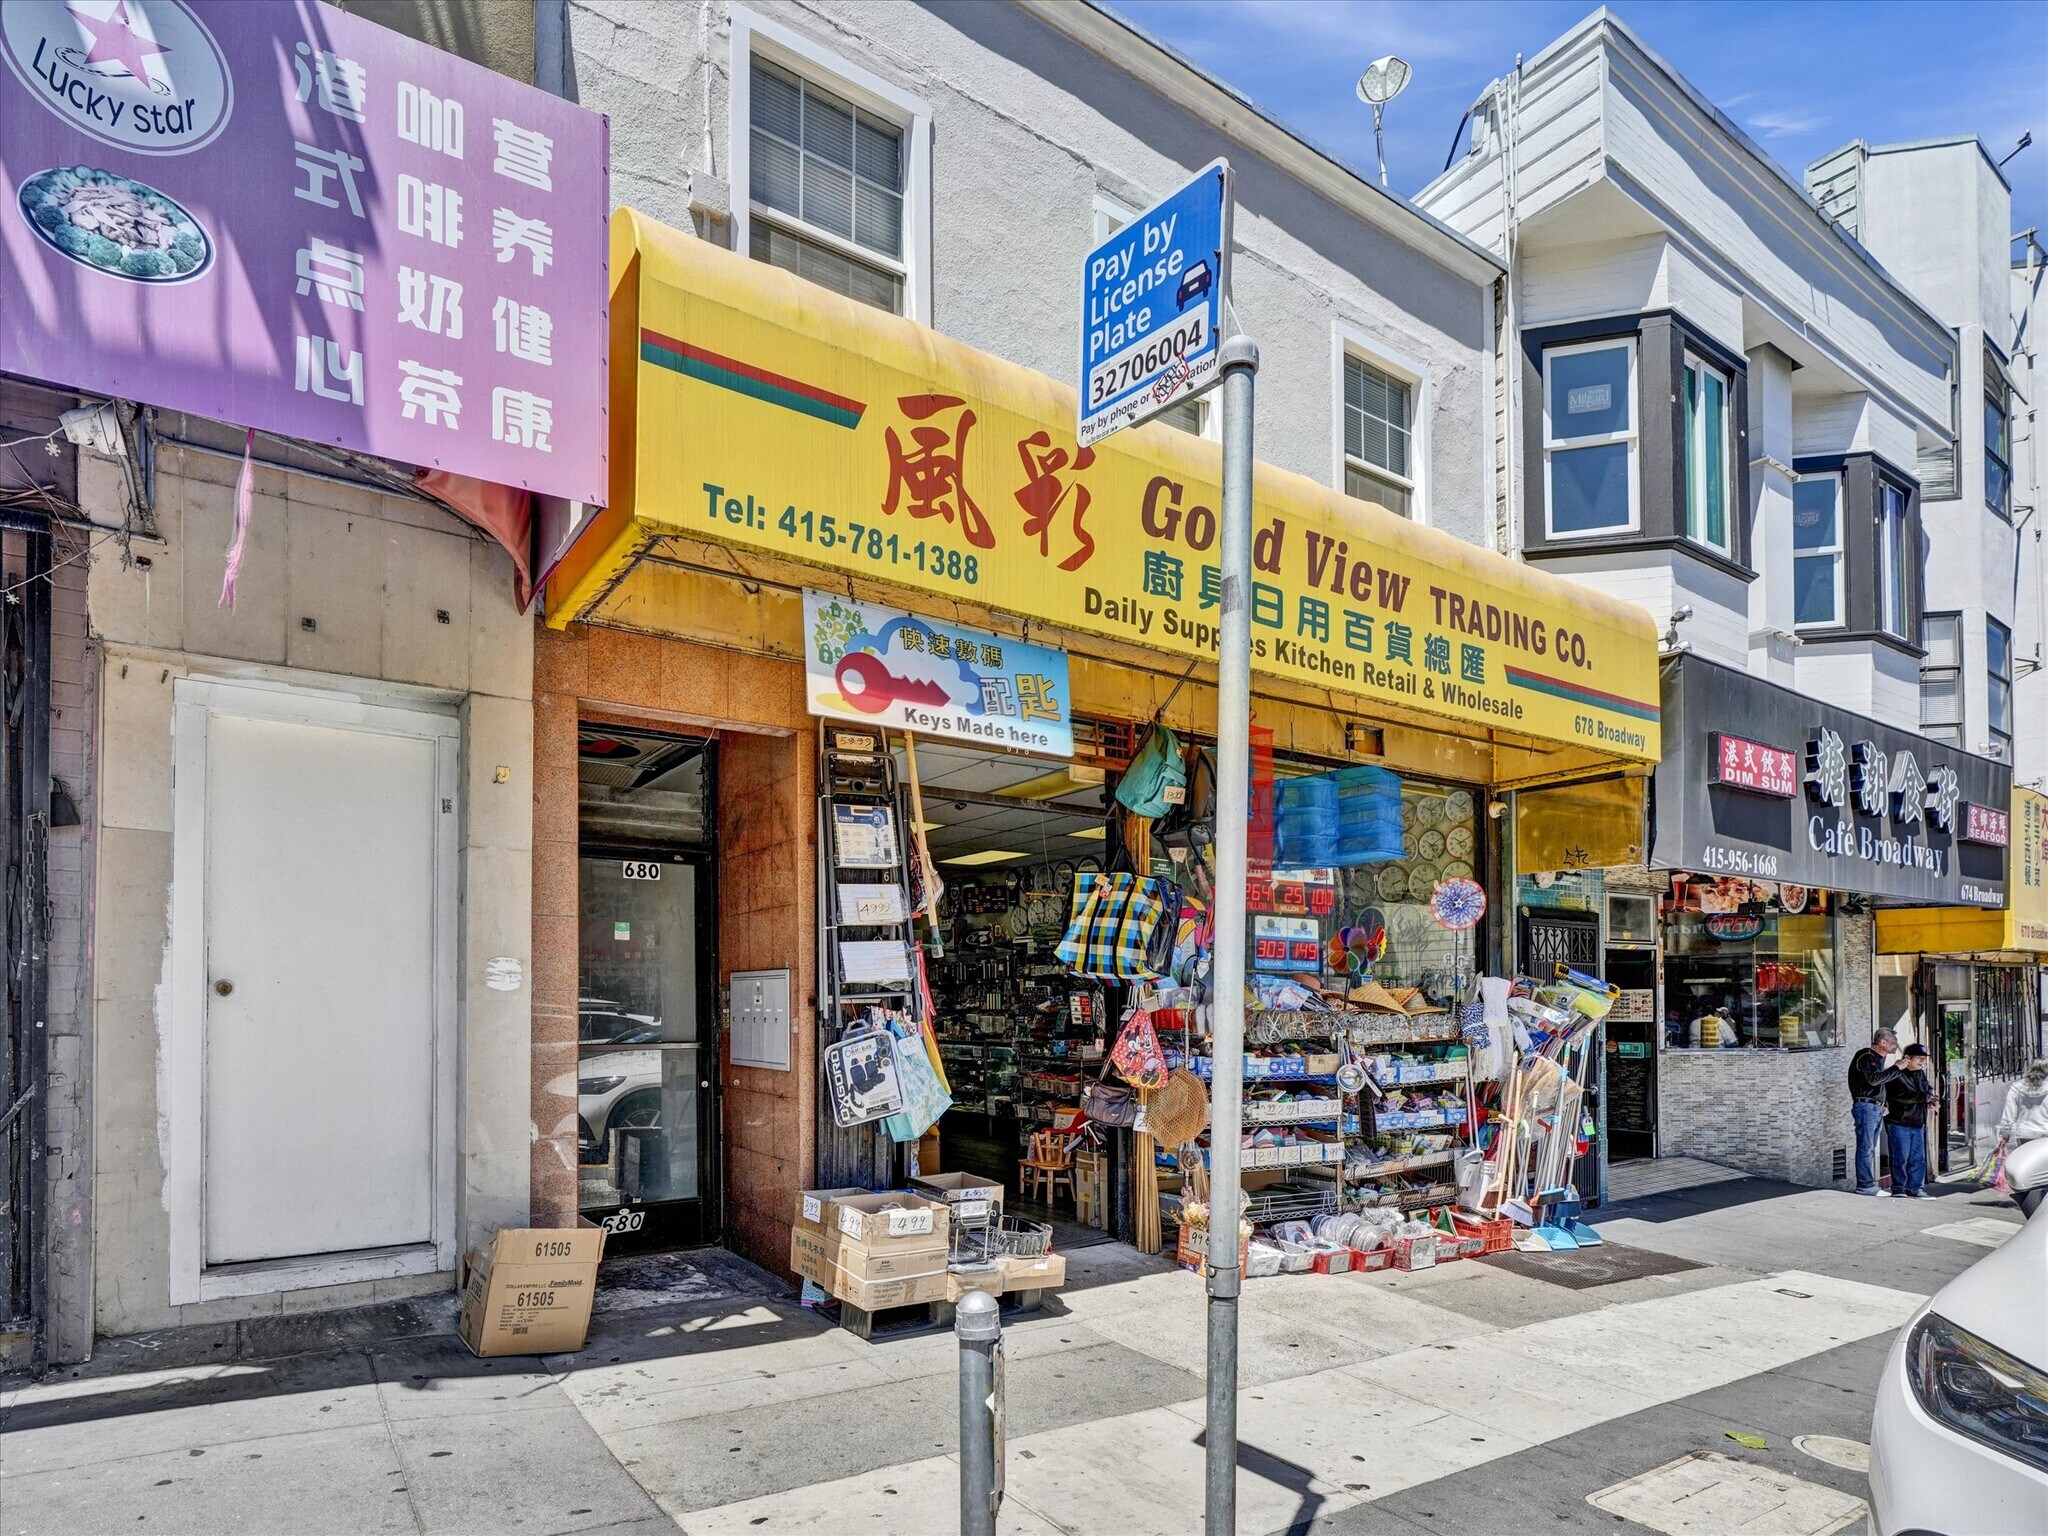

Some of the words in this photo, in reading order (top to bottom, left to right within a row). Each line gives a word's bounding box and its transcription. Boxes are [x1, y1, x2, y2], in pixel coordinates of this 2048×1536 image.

[31, 37, 122, 127] Lucky
[133, 96, 195, 136] star
[294, 41, 367, 407] 港式点心
[397, 81, 464, 430] 咖啡奶茶
[1092, 241, 1135, 291] Pay
[1143, 212, 1177, 257] by
[491, 117, 553, 454] 营养健康
[1091, 248, 1184, 327] License
[1090, 307, 1151, 362] Plate
[1092, 318, 1202, 404] 32706004
[1081, 423, 1096, 436] Pay
[1097, 416, 1108, 429] by
[1110, 400, 1138, 423] phone
[1140, 392, 1150, 405] or
[1184, 357, 1216, 381] tation
[1570, 390, 1609, 407] Milgard
[702, 482, 765, 530] Tel:
[778, 505, 979, 585] 415-781-1388
[1141, 475, 1285, 576] God
[1305, 529, 1410, 613] View
[1429, 586, 1546, 656] TRADING
[1555, 628, 1592, 670] CO.
[1084, 587, 1153, 635] Daily
[1275, 639, 1355, 680] Kitchen
[1363, 662, 1418, 695] Retail
[1423, 680, 1435, 699] &
[1442, 682, 1523, 720] Wholesale
[904, 707, 952, 731] Keys
[957, 716, 1005, 739] Made
[1009, 726, 1049, 747] here
[1574, 715, 1594, 737] 678
[1597, 721, 1646, 752] Broadway
[1725, 740, 1792, 779] 港式飲茶
[1725, 767, 1753, 785] DIM
[1762, 776, 1792, 793] SUM
[1809, 815, 1854, 857] Café
[1860, 826, 1943, 878] Broadway
[1970, 829, 2006, 844] SEAFOOD
[625, 862, 659, 879] 680
[1703, 845, 1777, 876] 415-956-1668
[1284, 886, 1303, 904] 25
[1961, 884, 1973, 901] 674
[1974, 886, 2004, 908] Broadway
[1708, 916, 1760, 933] OPEN
[1257, 941, 1286, 958] 303
[1294, 943, 1318, 959] 149
[603, 1213, 642, 1233] 680
[535, 1242, 571, 1257] 61505
[517, 1292, 554, 1307] 61505
[548, 1279, 583, 1288] FamilyMaid
